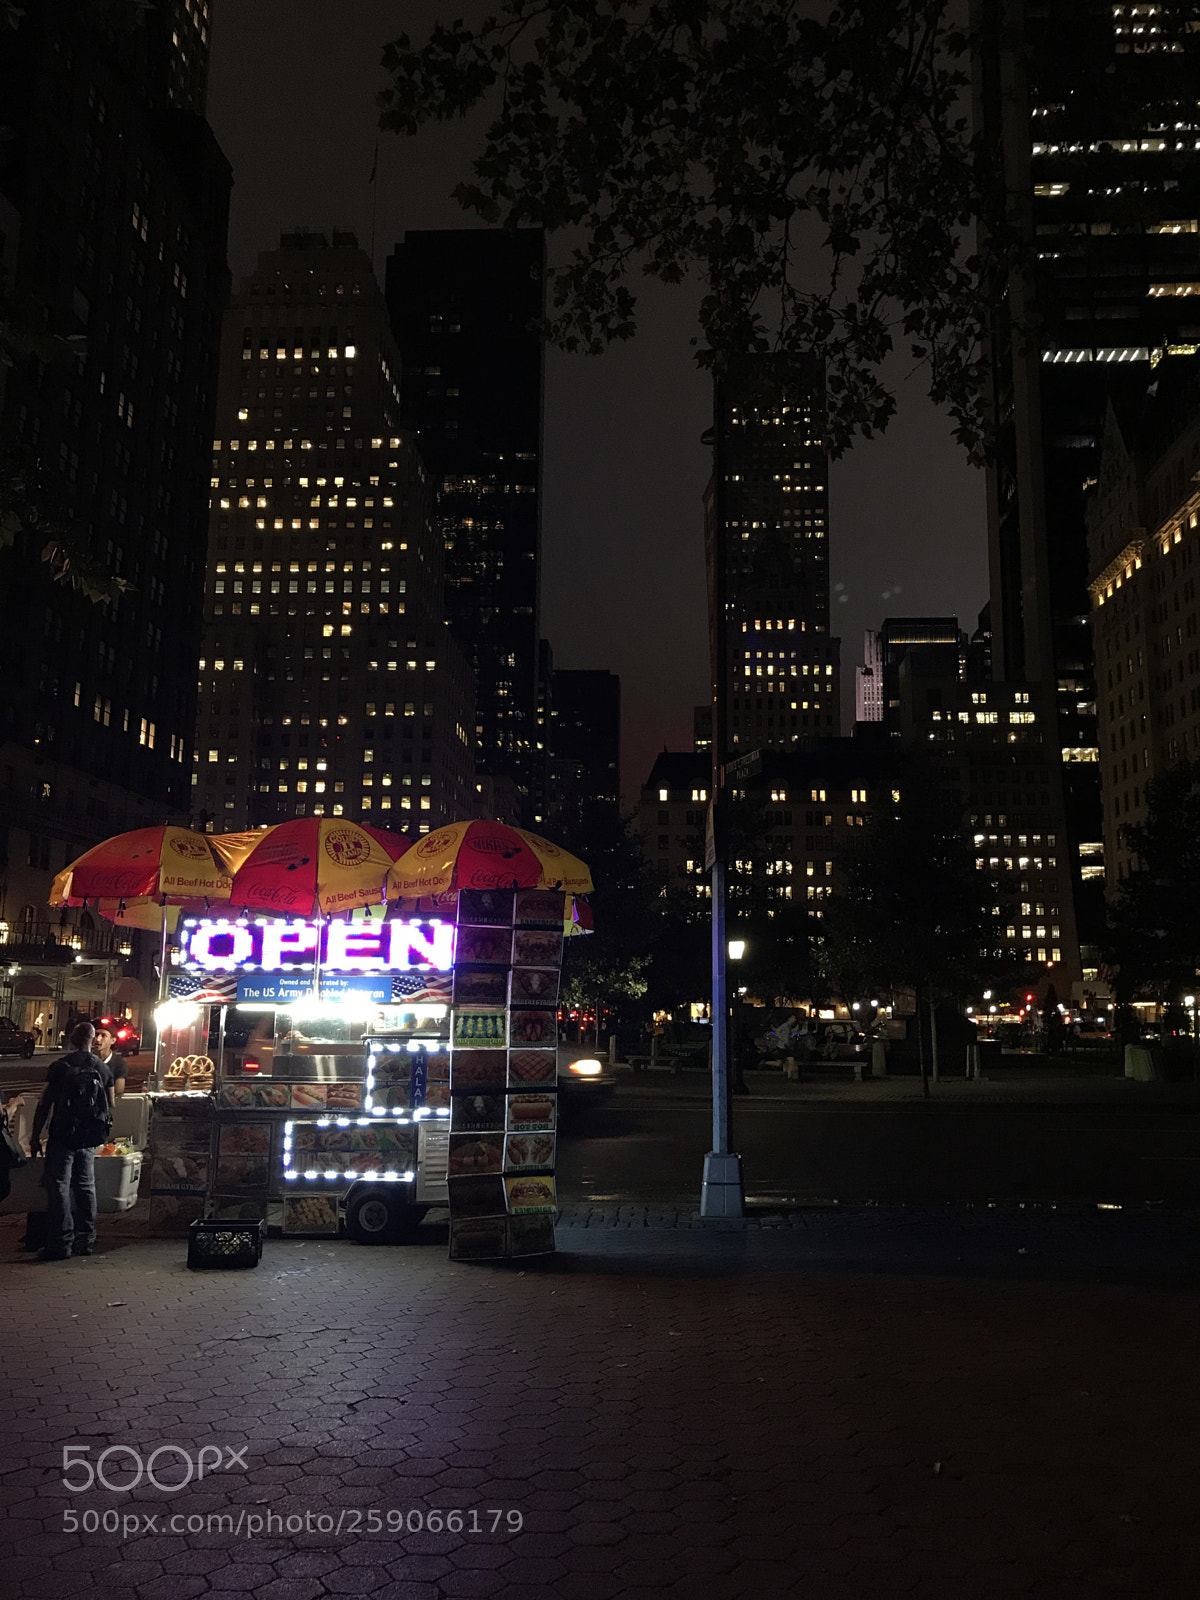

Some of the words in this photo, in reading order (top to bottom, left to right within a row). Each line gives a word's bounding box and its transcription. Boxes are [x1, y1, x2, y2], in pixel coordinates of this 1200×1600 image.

[163, 876, 176, 885] All
[177, 877, 198, 887] Beef
[199, 879, 215, 888] Hot
[392, 880, 402, 890] All
[403, 879, 418, 889] Beef
[418, 877, 432, 887] Hot
[326, 895, 337, 905] All
[337, 890, 357, 902] Beef
[188, 923, 452, 970] OPEN
[243, 987, 260, 998] The
[262, 987, 275, 998] US
[278, 987, 304, 999] Army
[305, 987, 346, 998] Dabled
[413, 1055, 424, 1108] HALAL
